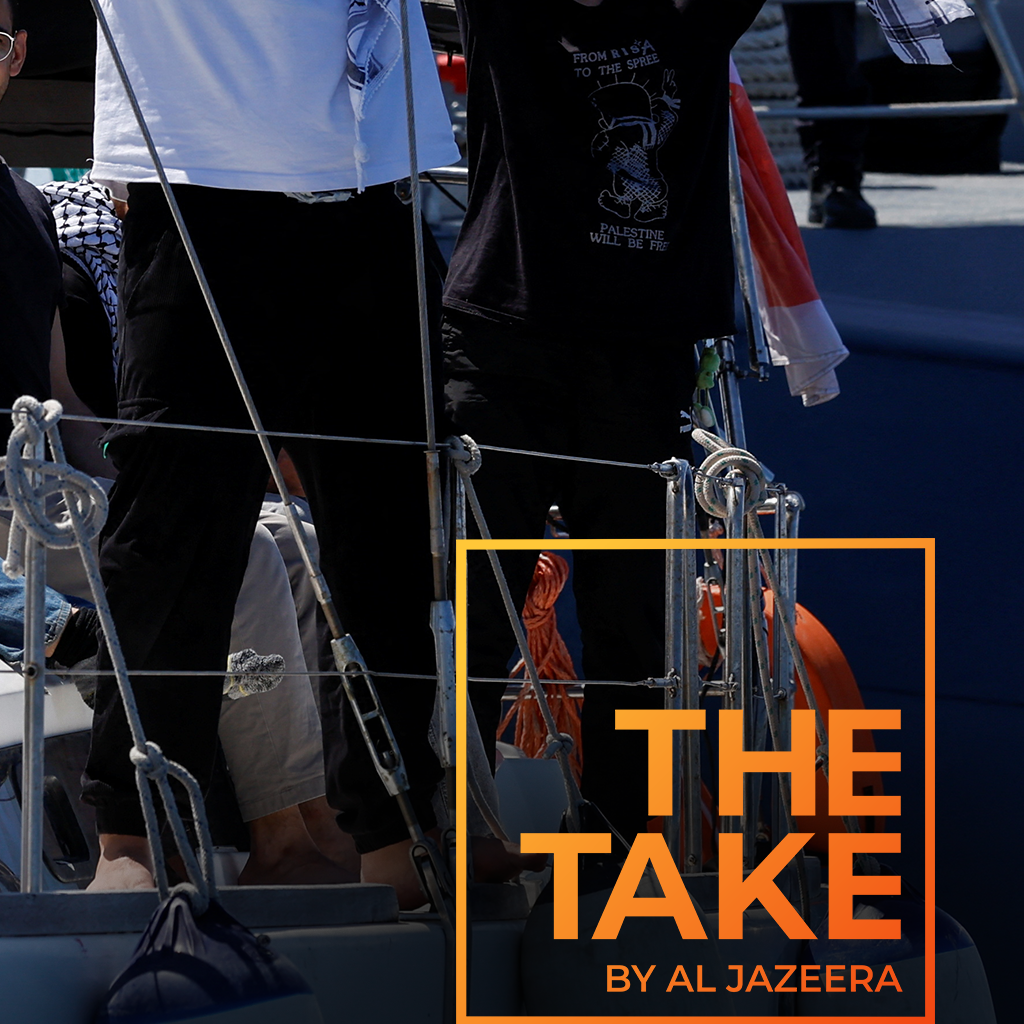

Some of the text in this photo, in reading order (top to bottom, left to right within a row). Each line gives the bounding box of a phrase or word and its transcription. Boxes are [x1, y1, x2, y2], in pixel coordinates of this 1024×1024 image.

[573, 50, 607, 64] FROM
[574, 53, 660, 78] TO THE SPREE
[589, 232, 622, 247] WILL
[628, 237, 644, 249] BE
[599, 222, 665, 241] PALESTINE
